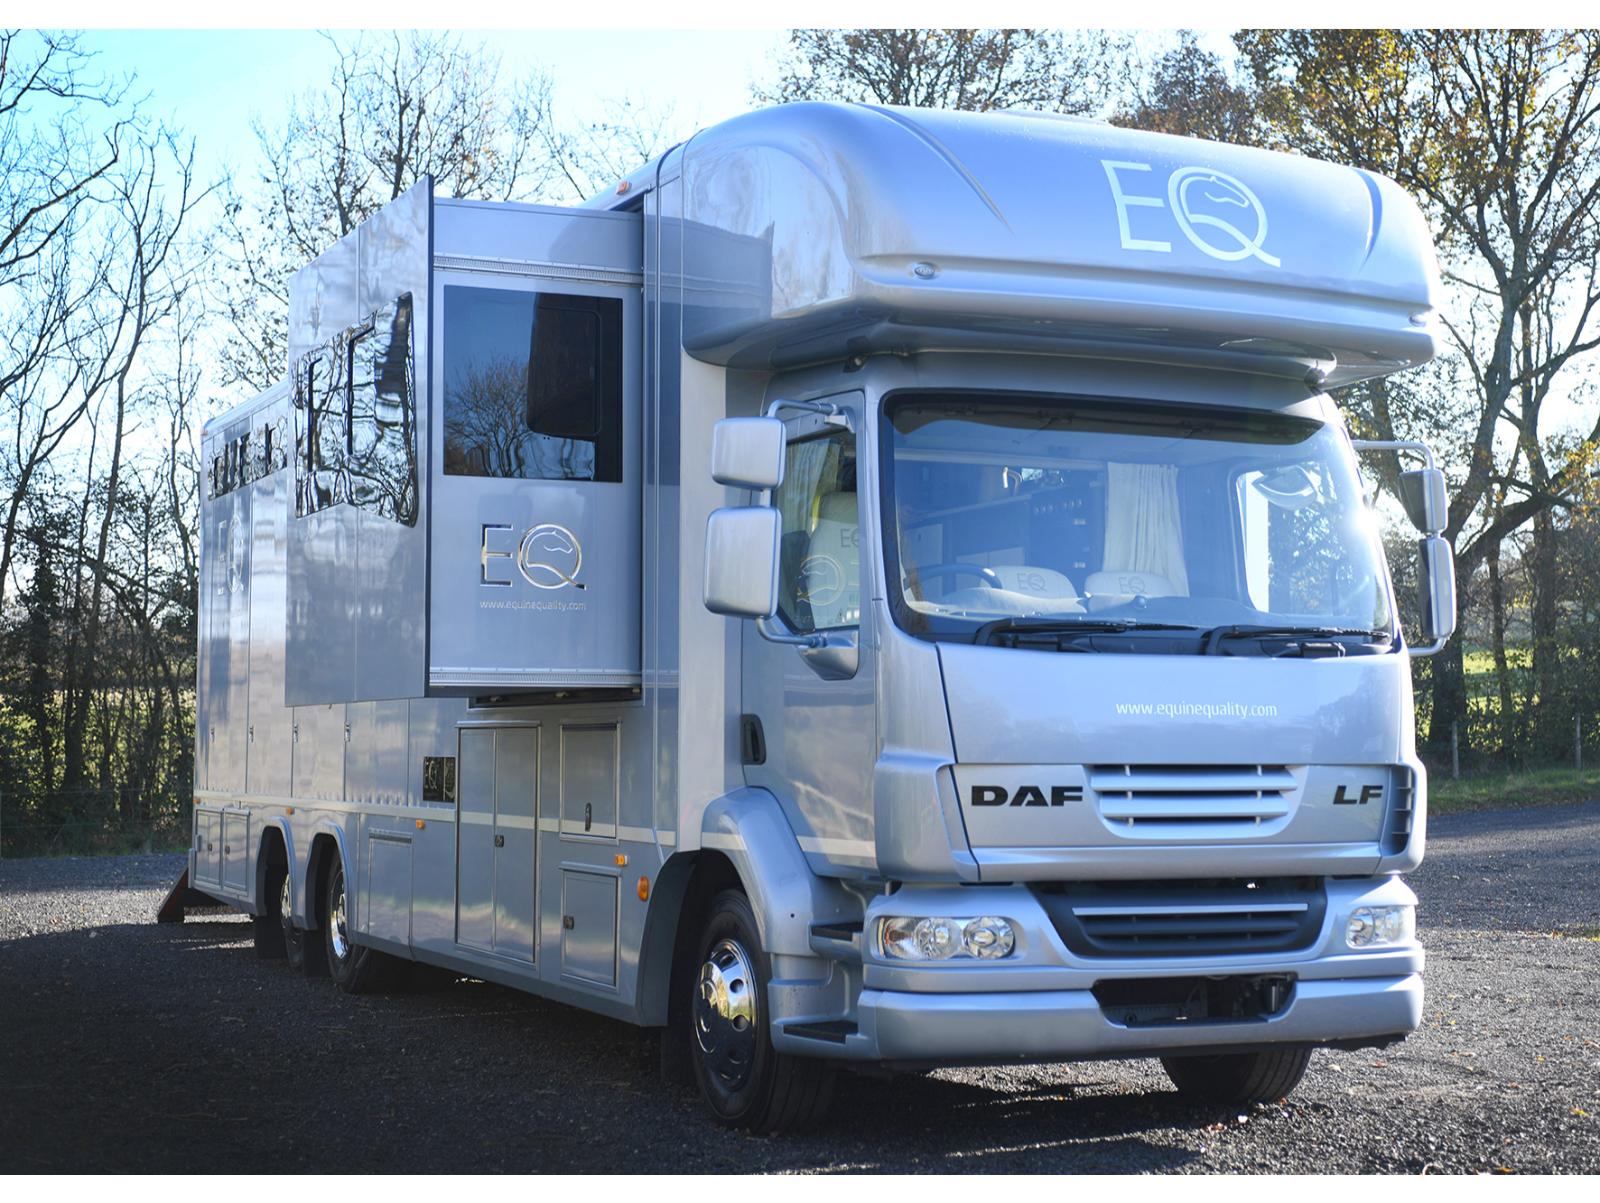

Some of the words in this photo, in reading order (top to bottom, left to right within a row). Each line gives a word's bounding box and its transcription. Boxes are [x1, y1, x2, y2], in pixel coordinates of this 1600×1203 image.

[1101, 159, 1281, 268] EQ
[481, 523, 586, 591] EQ
[1016, 572, 1048, 592] EQ
[480, 600, 586, 612] www.equinequality.com
[1115, 701, 1278, 719] www.equinequality.com
[971, 785, 1083, 807] DAF
[1333, 785, 1384, 805] LF
